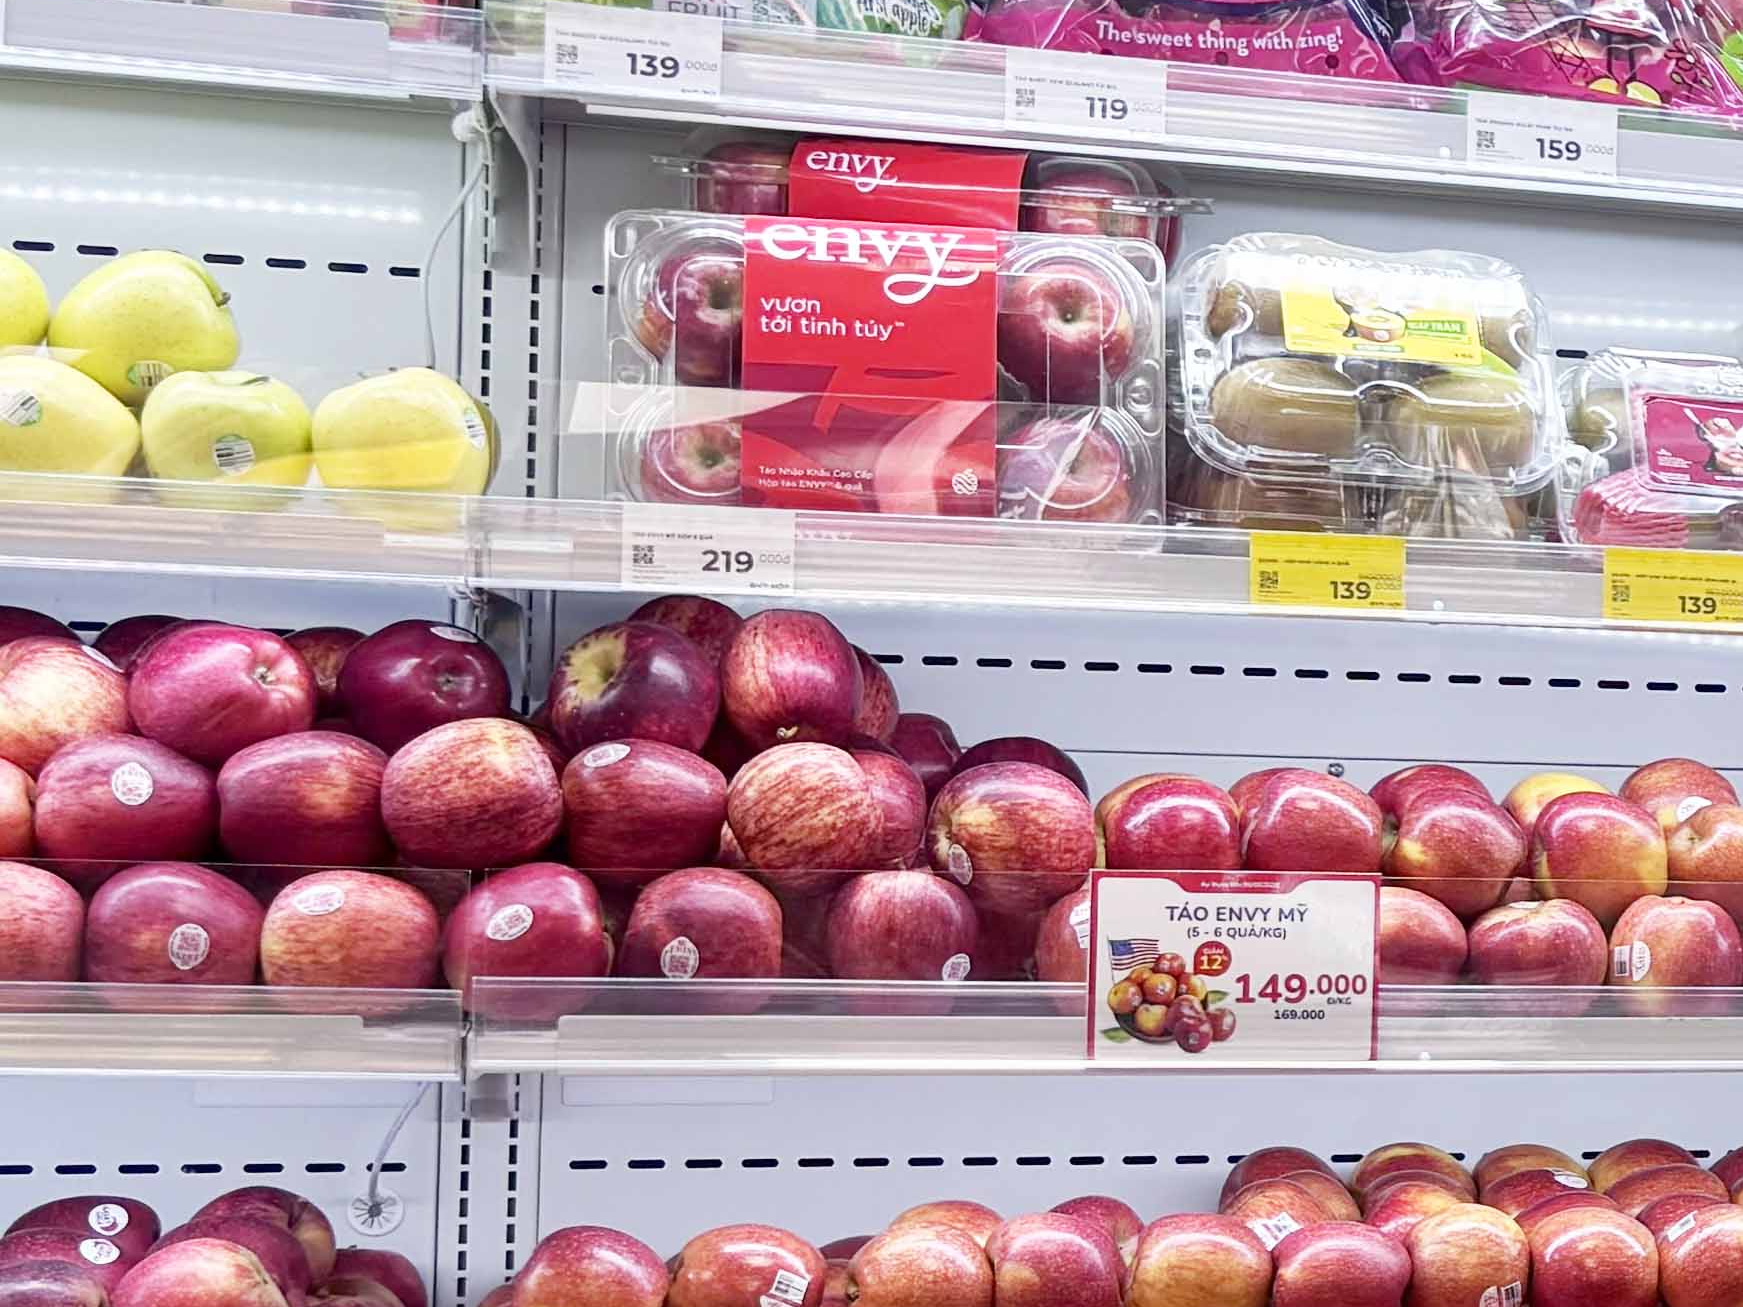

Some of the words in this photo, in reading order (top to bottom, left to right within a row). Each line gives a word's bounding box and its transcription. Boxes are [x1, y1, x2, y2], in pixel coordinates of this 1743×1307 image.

[1097, 21, 1132, 41] The
[1136, 30, 1192, 48] sweet
[1199, 31, 1248, 56] thing
[1253, 30, 1293, 50] with
[1299, 26, 1343, 56] zing!
[627, 53, 679, 78] 139
[1086, 97, 1128, 120] 119
[1536, 138, 1581, 161] 159
[806, 151, 896, 192] envy
[760, 224, 980, 304] envy
[760, 298, 821, 314] vươn
[760, 313, 792, 333] tới
[801, 316, 846, 335] tinh
[702, 549, 753, 573] 219
[1330, 581, 1371, 600] 139
[1678, 596, 1716, 614] 139
[1166, 902, 1208, 922] TÁO
[1216, 907, 1269, 922] ENVY
[1278, 903, 1308, 922] MỸ
[1235, 973, 1367, 1004] 149.000
[1274, 1009, 1325, 1020] 169.000
